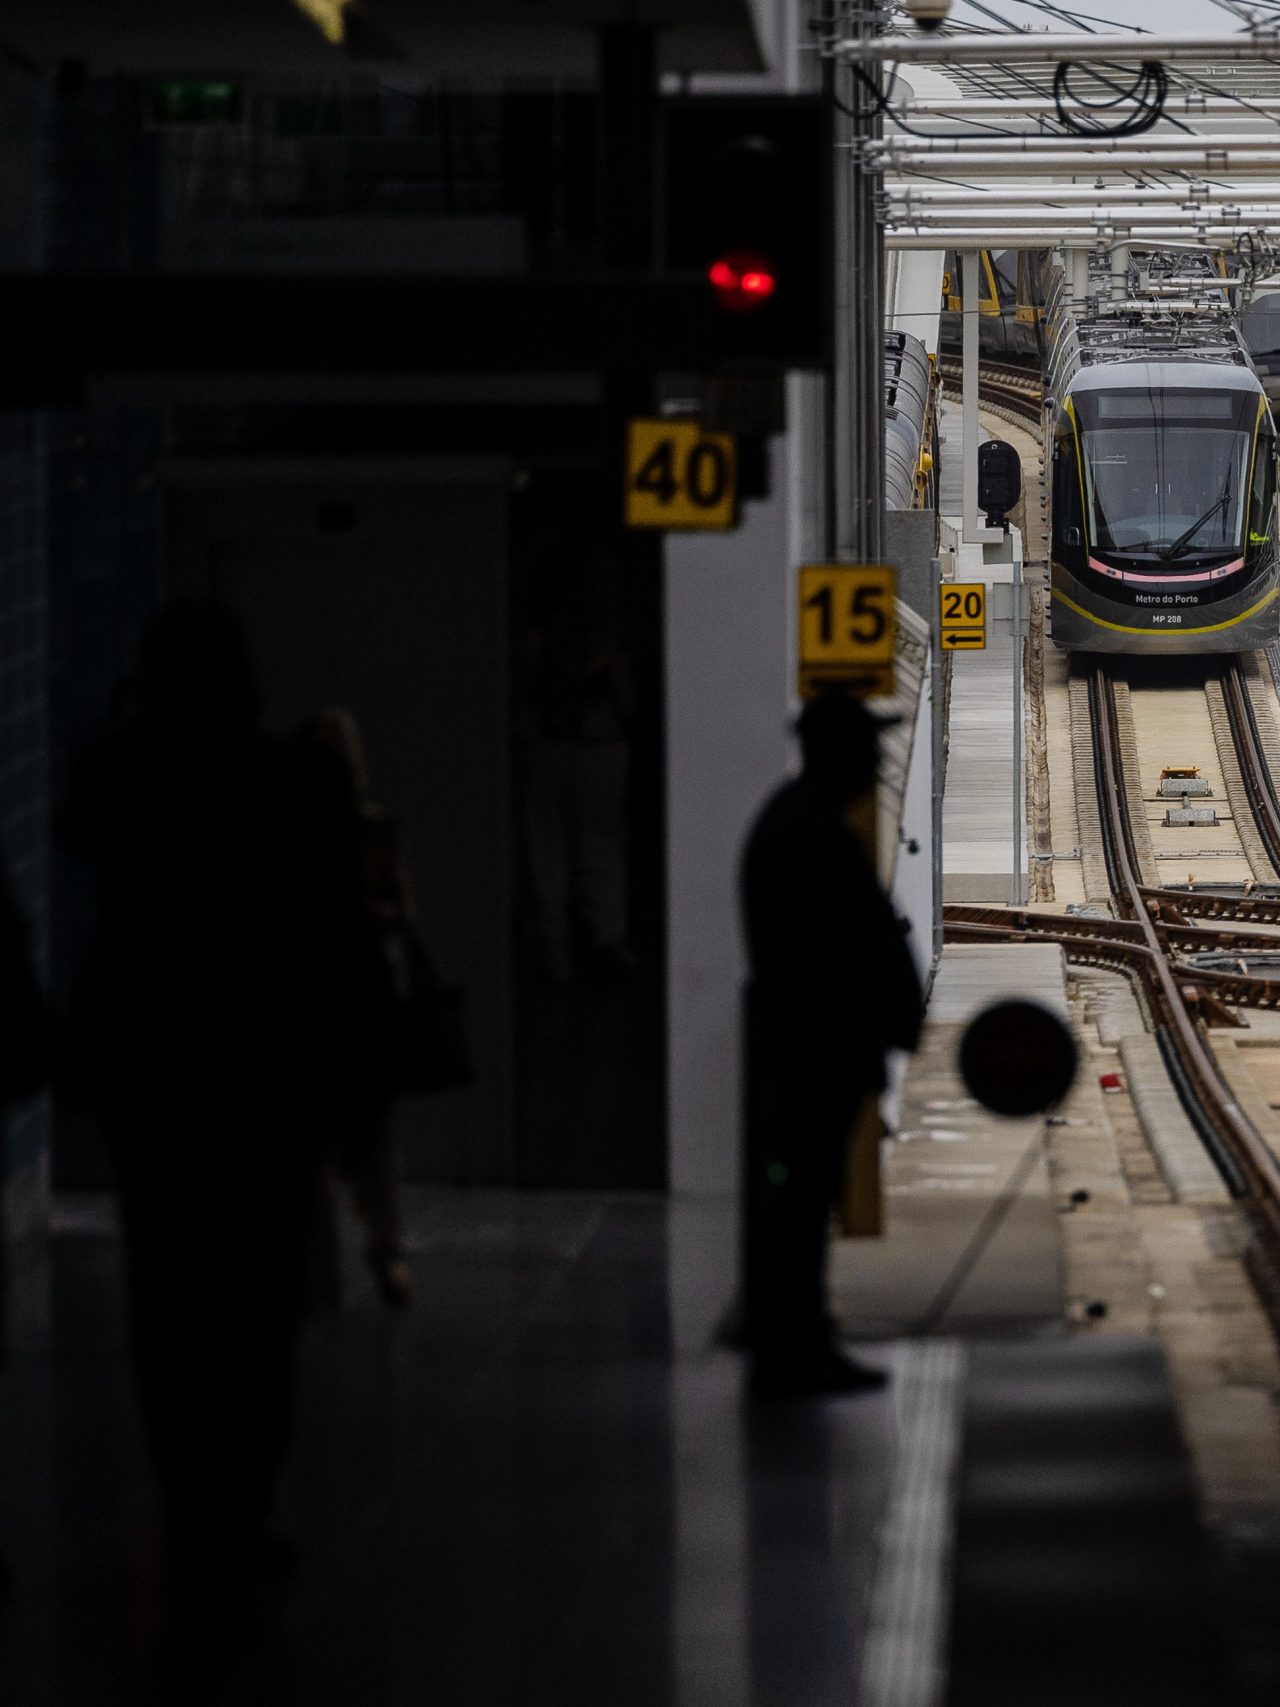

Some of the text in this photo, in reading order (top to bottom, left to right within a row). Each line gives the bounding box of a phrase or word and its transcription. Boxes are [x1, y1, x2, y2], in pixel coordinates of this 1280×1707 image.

[636, 439, 726, 507] 40
[944, 592, 982, 619] 20
[1136, 595, 1198, 603] Metro do Porto
[808, 586, 886, 645] 15
[1152, 615, 1182, 623] MP 208
